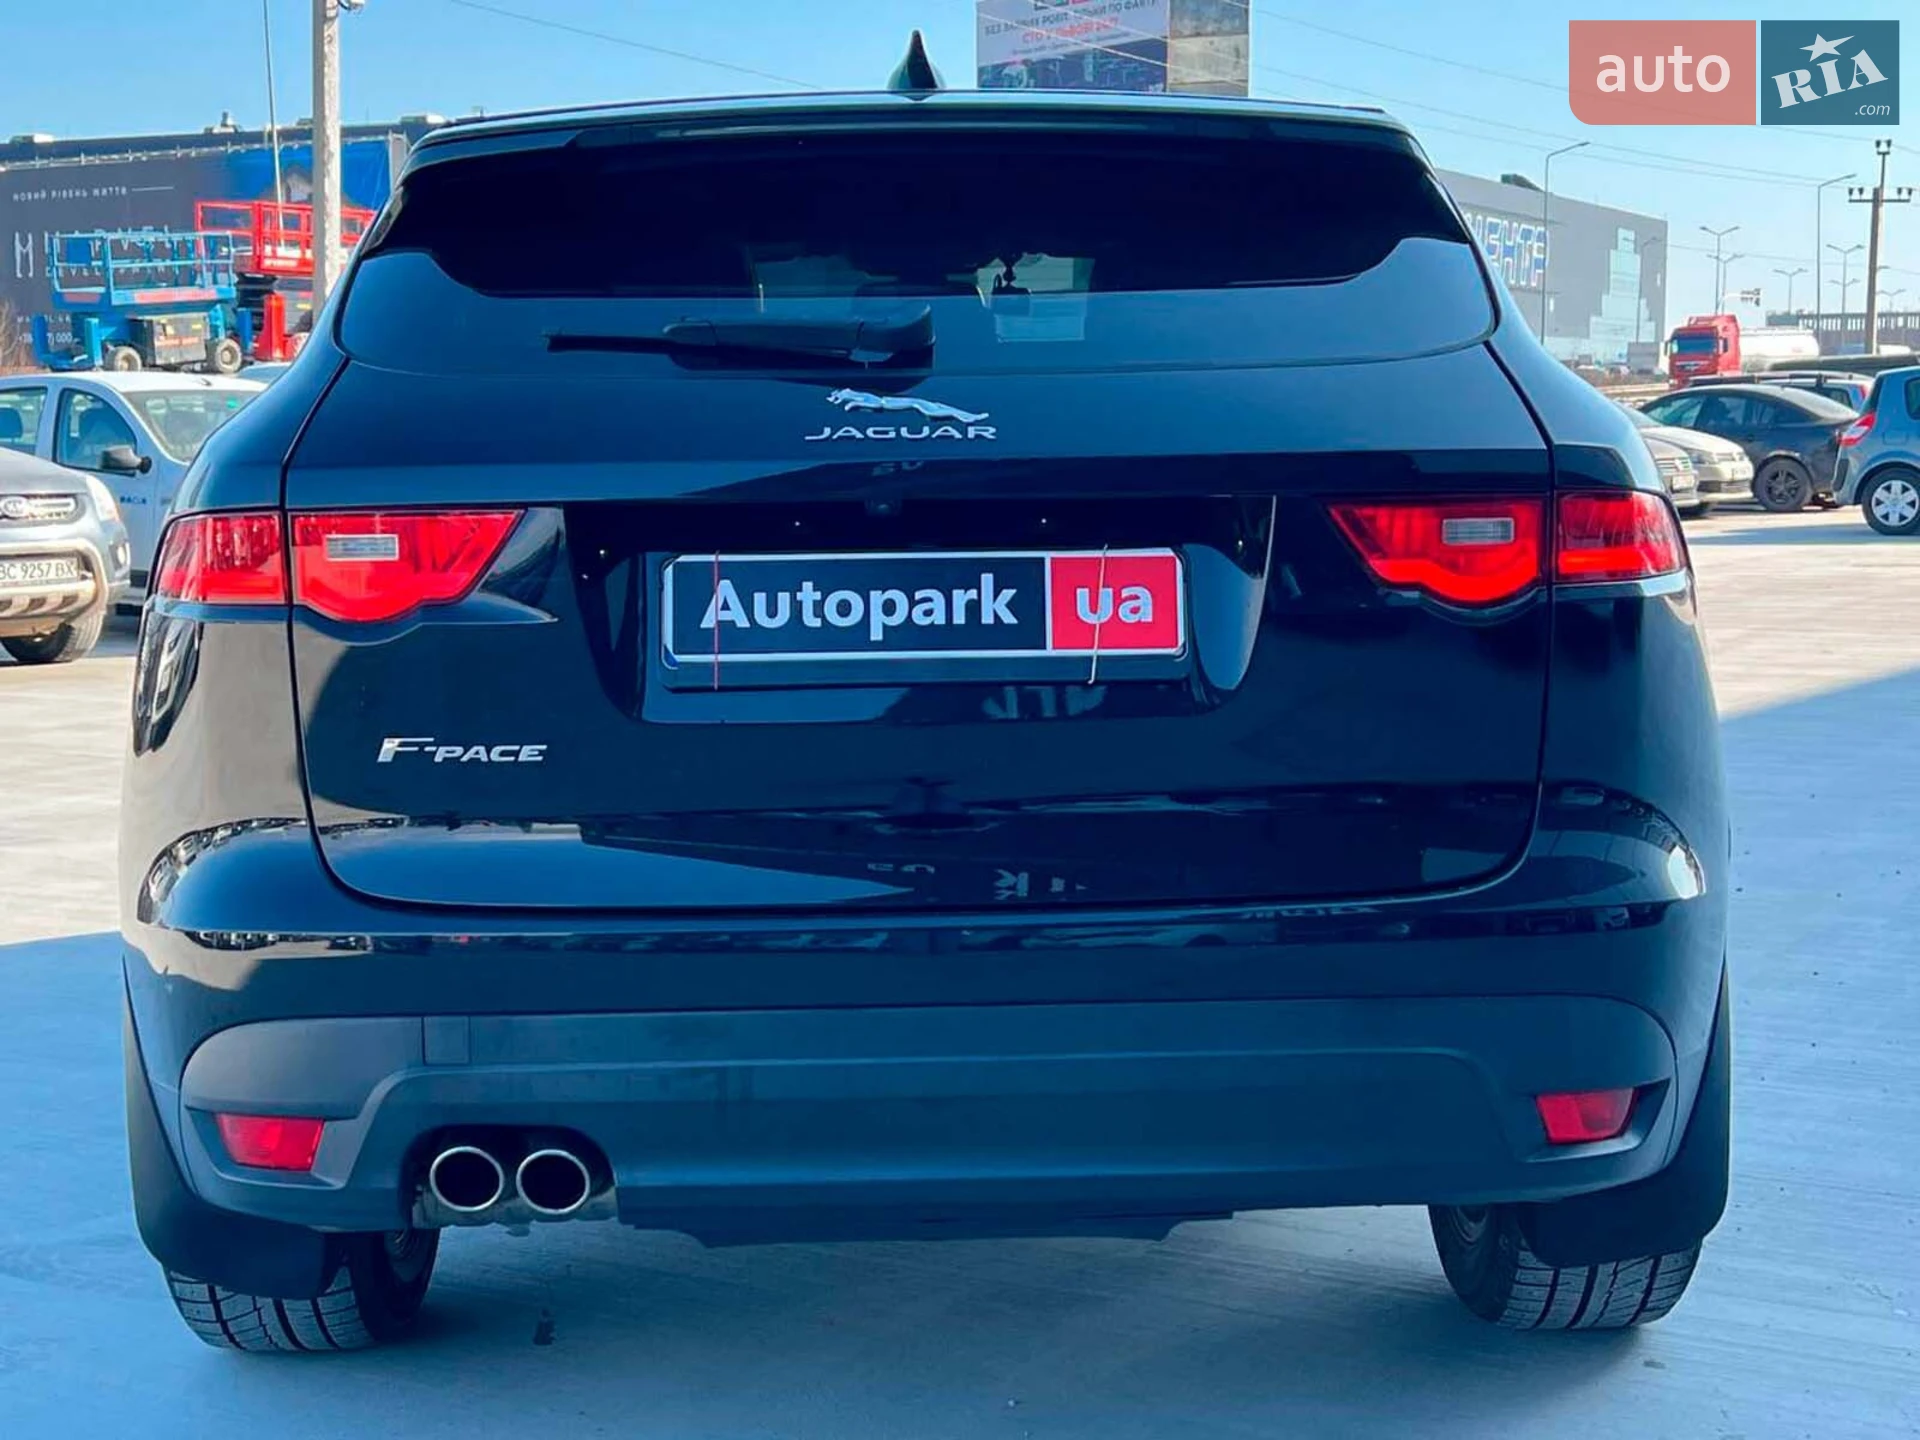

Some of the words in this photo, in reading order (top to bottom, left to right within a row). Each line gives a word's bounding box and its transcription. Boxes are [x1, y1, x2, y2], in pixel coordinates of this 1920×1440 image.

[805, 425, 998, 440] JAGUAR
[20, 562, 52, 579] 9257
[700, 573, 1019, 642] Autopark
[1075, 585, 1153, 625] ua
[377, 737, 548, 763] F-PACE
